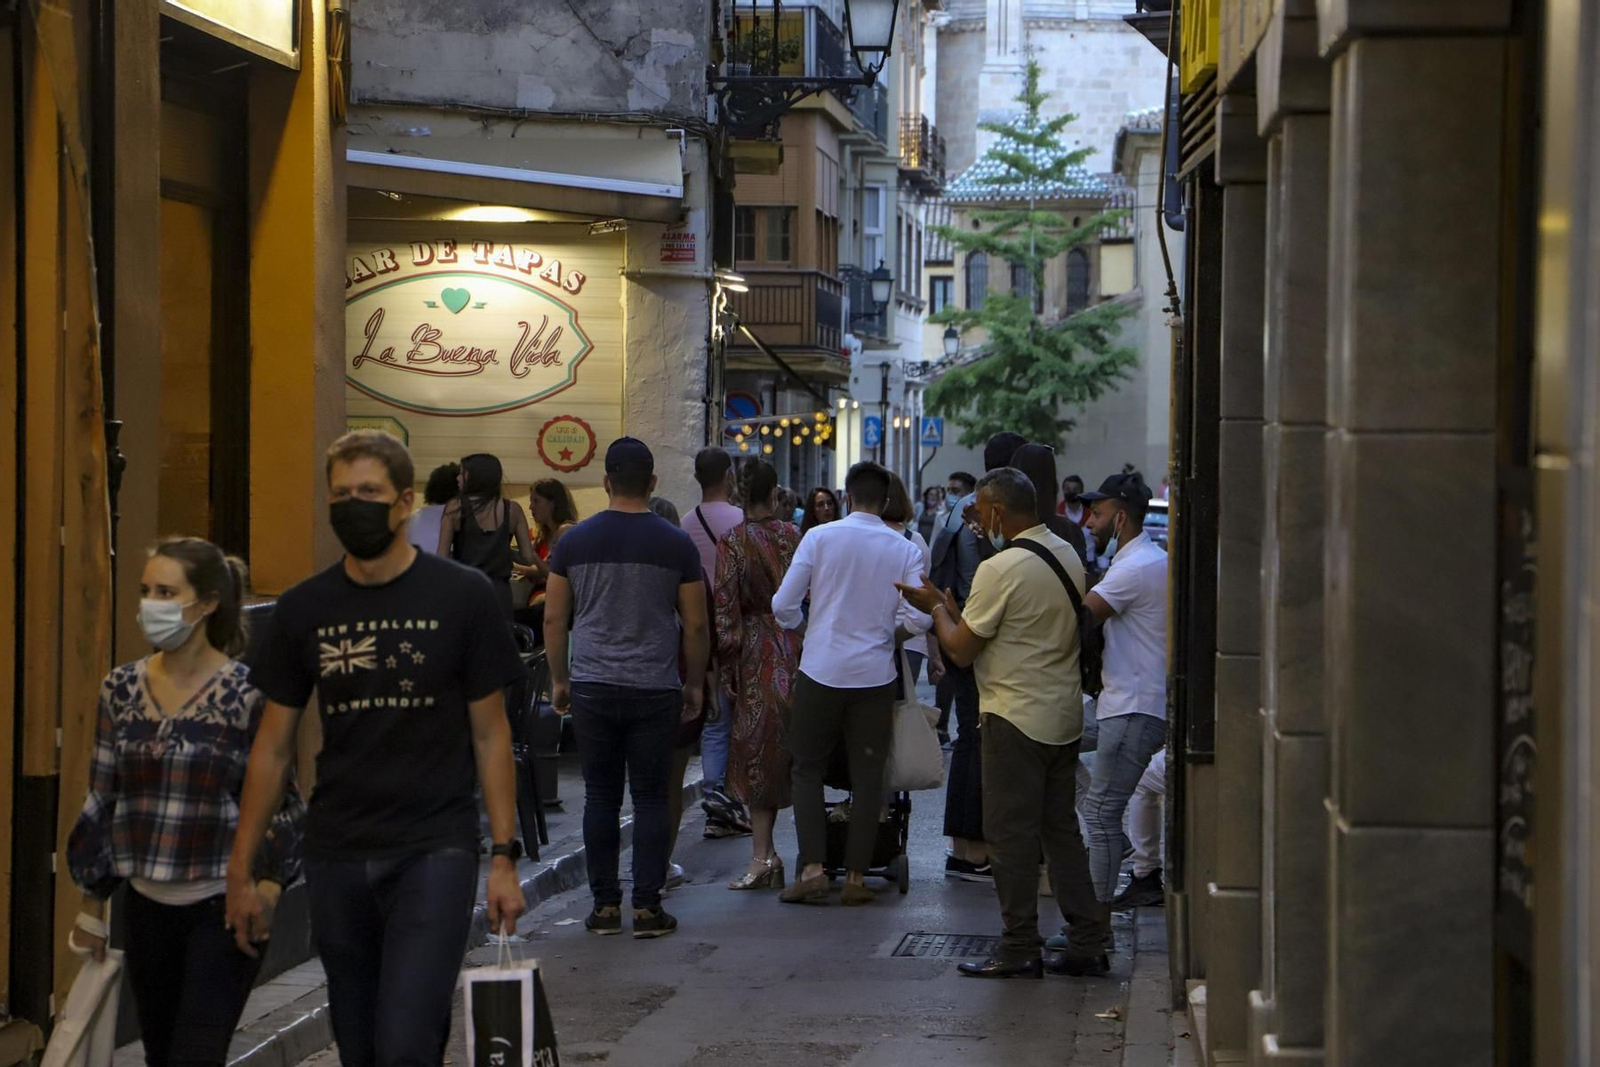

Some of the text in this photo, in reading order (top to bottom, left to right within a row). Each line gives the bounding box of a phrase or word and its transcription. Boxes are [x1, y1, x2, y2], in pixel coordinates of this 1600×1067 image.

[661, 232, 696, 241] ALARMA
[345, 239, 587, 296] AR DE TAPAS
[406, 322, 499, 367] Buena
[509, 314, 564, 379] Vida
[317, 619, 440, 637] NEW ZEALAND
[326, 696, 435, 714] DOWN UNDER
